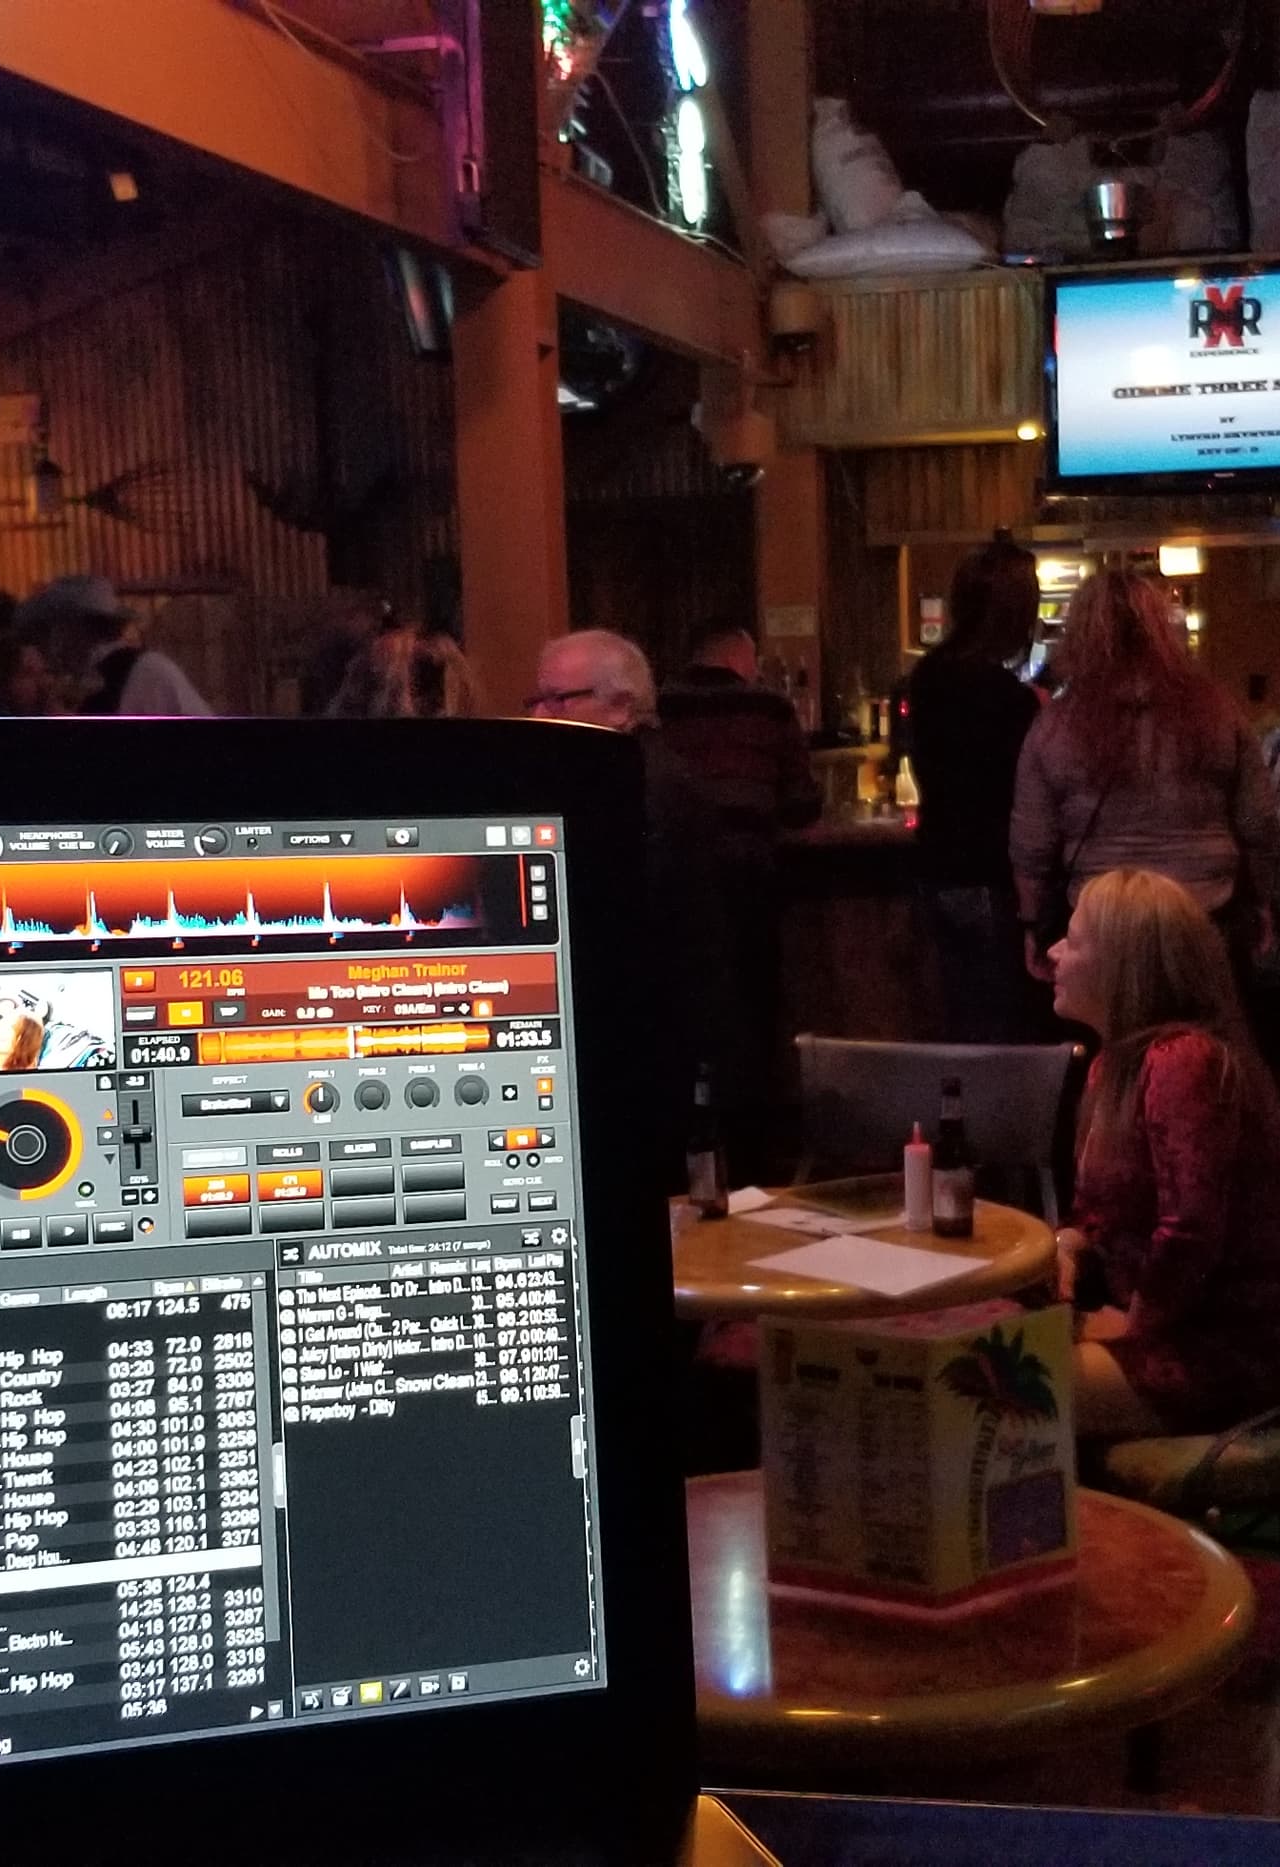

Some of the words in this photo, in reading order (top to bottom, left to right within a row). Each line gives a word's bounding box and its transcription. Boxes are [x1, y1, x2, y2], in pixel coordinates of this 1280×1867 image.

[1113, 385, 1191, 398] GIMME
[1197, 381, 1268, 394] THREE
[236, 827, 272, 835] LIMITER
[291, 836, 330, 844] OPTIONS
[179, 970, 243, 988] 121.06
[349, 964, 408, 981] Meghan
[413, 963, 467, 977] Trainor
[139, 1036, 180, 1046] ELAPSED
[497, 1032, 552, 1048] 01:33.5
[131, 1048, 191, 1063] 01:40.9
[308, 1241, 381, 1260] AUTOMIX
[156, 1297, 200, 1315] 124.5
[221, 1293, 251, 1310] 475
[108, 1340, 153, 1358] 04:33
[166, 1336, 202, 1354] 72.0
[0, 1351, 24, 1370] Hip
[33, 1349, 64, 1366] Hop
[109, 1360, 154, 1378] 03:20
[167, 1356, 202, 1374] 72.0
[214, 1352, 253, 1370] 2502
[0, 1368, 62, 1389] Country
[396, 1380, 431, 1393] Snow
[109, 1379, 155, 1398] 03:27
[1, 1390, 43, 1407] Rock
[1, 1412, 27, 1430] Hip
[34, 1409, 65, 1426] Hop
[302, 1404, 356, 1421] Paperboy
[111, 1419, 157, 1438] 04:30
[160, 1414, 204, 1433] 101.0
[3, 1432, 28, 1450] Hip
[35, 1429, 66, 1447] Hop
[3, 1452, 53, 1467] House
[112, 1458, 158, 1478] 04:23
[162, 1454, 204, 1473] 102.1
[219, 1449, 256, 1468] 3251
[3, 1470, 53, 1488] Twerk
[163, 1474, 205, 1493] 102.1
[4, 1493, 54, 1507] House
[164, 1494, 206, 1513] 103.1
[5, 1513, 31, 1531] Hip
[35, 1510, 68, 1527] Hop
[115, 1518, 160, 1538] 03:33
[5, 1533, 39, 1551] Pop
[222, 1528, 258, 1547] 3371
[119, 1598, 163, 1618] 14:25
[226, 1627, 264, 1646] 3525
[119, 1638, 164, 1659] 05:43
[120, 1658, 164, 1679] 03:41
[11, 1676, 37, 1694] Hip
[41, 1671, 74, 1692] Hop
[121, 1678, 165, 1699] 03:17
[171, 1673, 212, 1693] 137.1
